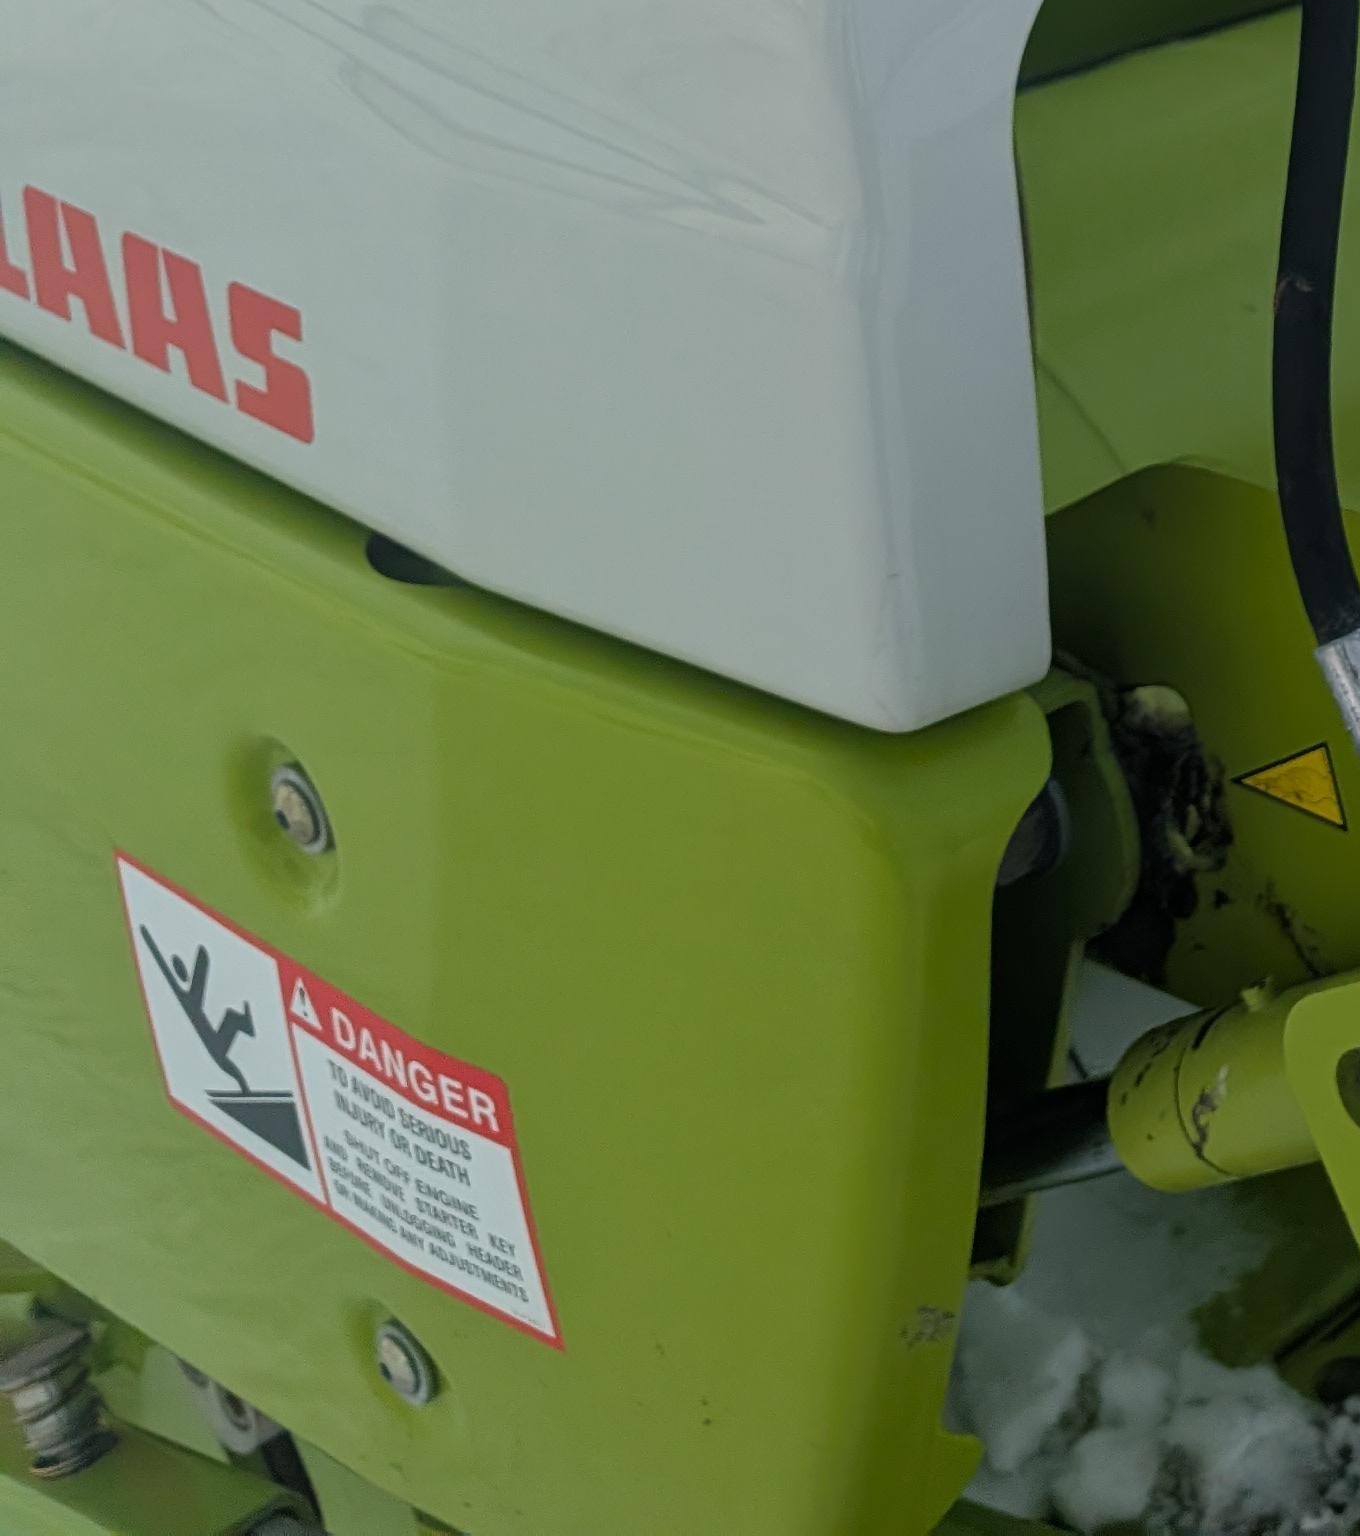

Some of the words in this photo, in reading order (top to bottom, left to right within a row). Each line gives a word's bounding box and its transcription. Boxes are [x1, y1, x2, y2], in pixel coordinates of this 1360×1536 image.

[328, 1058, 350, 1088] TO
[351, 1074, 395, 1120] AVOID
[398, 1106, 473, 1162] SERIOUS
[331, 1006, 500, 1133] DANGER
[334, 1090, 387, 1142] INJURY
[390, 1128, 413, 1158] OR
[414, 1143, 472, 1187] DEATH
[344, 1129, 381, 1167] SHUT
[385, 1156, 411, 1186] OFF
[415, 1178, 481, 1222] ENGINE
[324, 1135, 349, 1162] AND
[356, 1156, 406, 1203] REMOVE
[415, 1196, 479, 1239] STARTER
[488, 1232, 516, 1257] KEY
[399, 1223, 425, 1252] ANY
[428, 1242, 530, 1304] ADJUSTMENTS
[466, 1241, 524, 1281] HEADER
